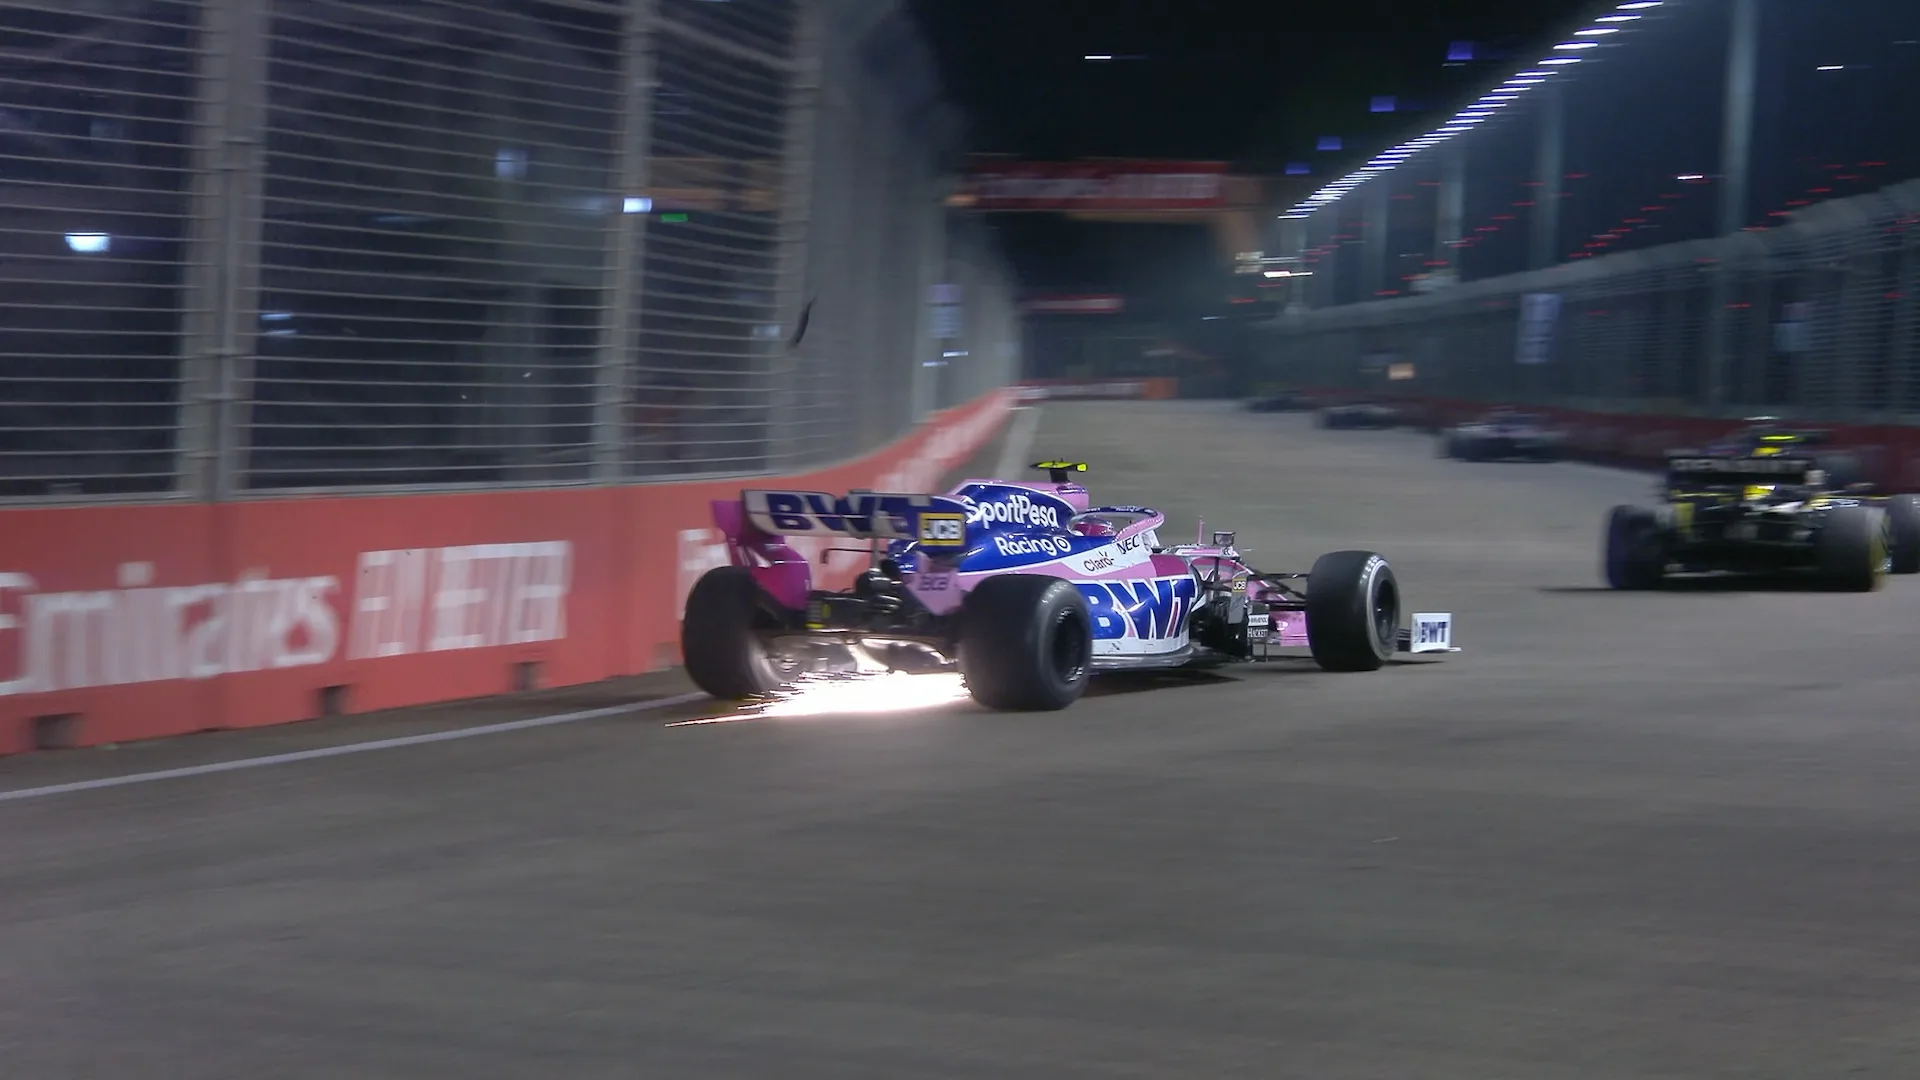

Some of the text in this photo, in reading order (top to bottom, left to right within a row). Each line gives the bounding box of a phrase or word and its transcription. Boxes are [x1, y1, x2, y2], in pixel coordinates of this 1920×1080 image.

[961, 495, 1060, 529] SportPesa
[922, 519, 963, 540] JCB
[994, 536, 1058, 556] Racing
[1116, 534, 1140, 555] NEC
[1083, 554, 1113, 572] Claro
[1073, 578, 1197, 640] BWT
[1420, 621, 1448, 643] BWT
